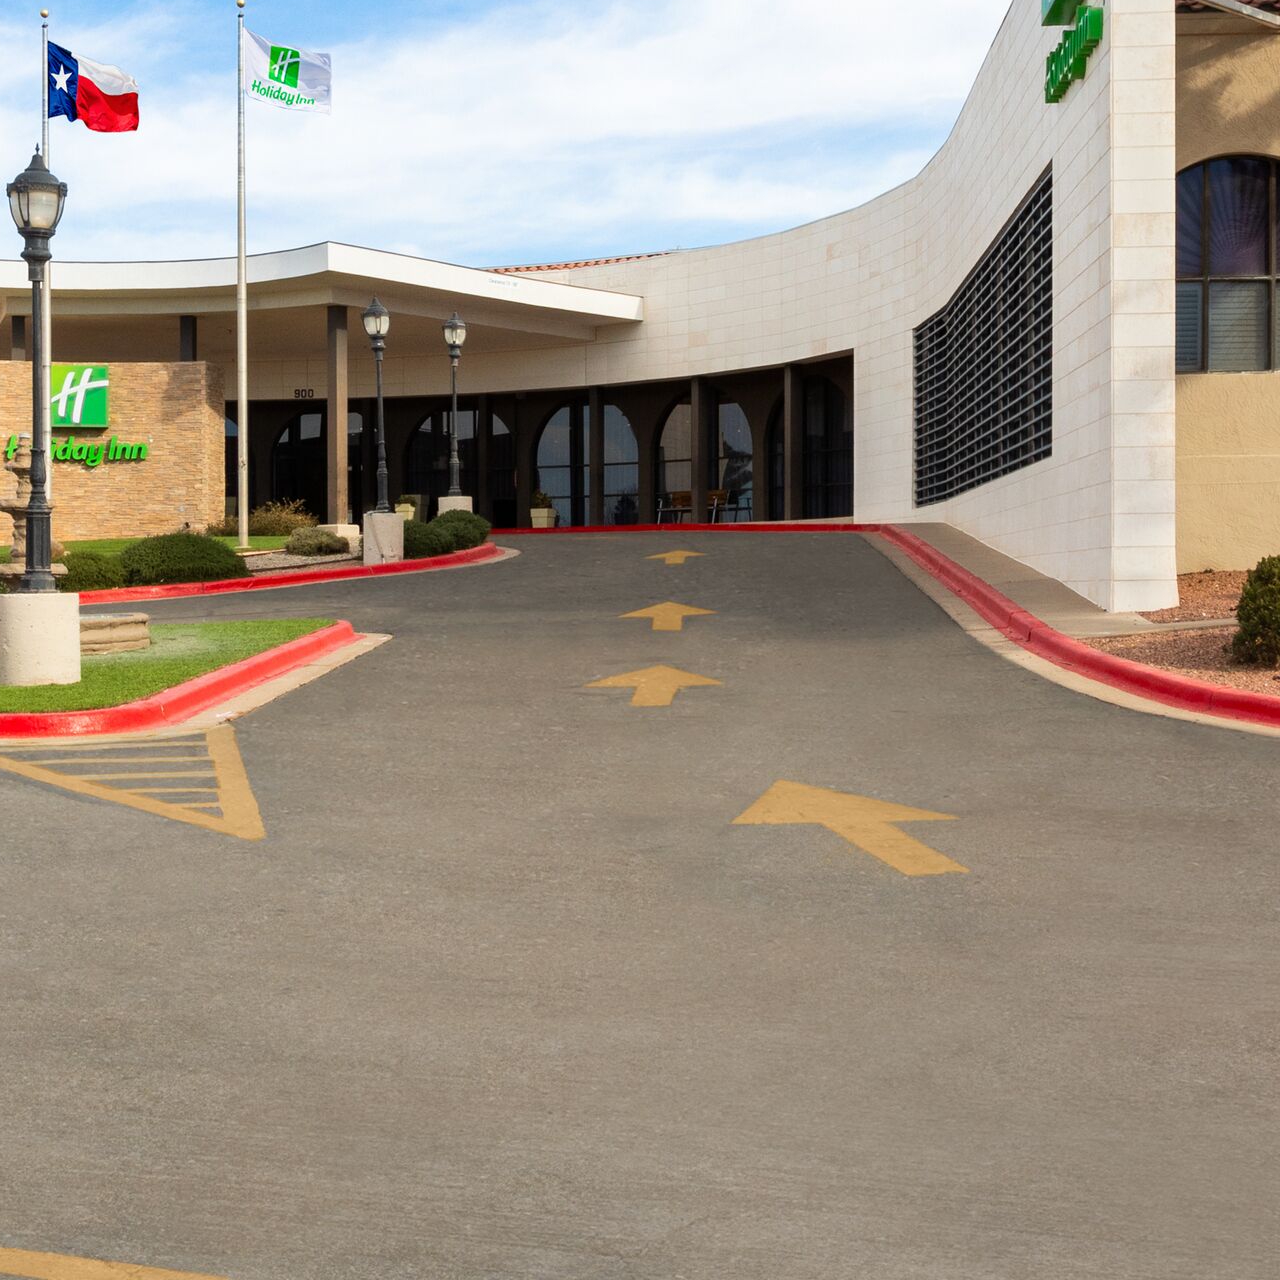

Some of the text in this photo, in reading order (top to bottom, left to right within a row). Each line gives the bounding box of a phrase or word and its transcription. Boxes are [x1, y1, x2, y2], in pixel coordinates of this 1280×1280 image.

[251, 80, 315, 106] Holiday Inn
[294, 389, 314, 398] 900
[5, 434, 148, 466] iday Inn
